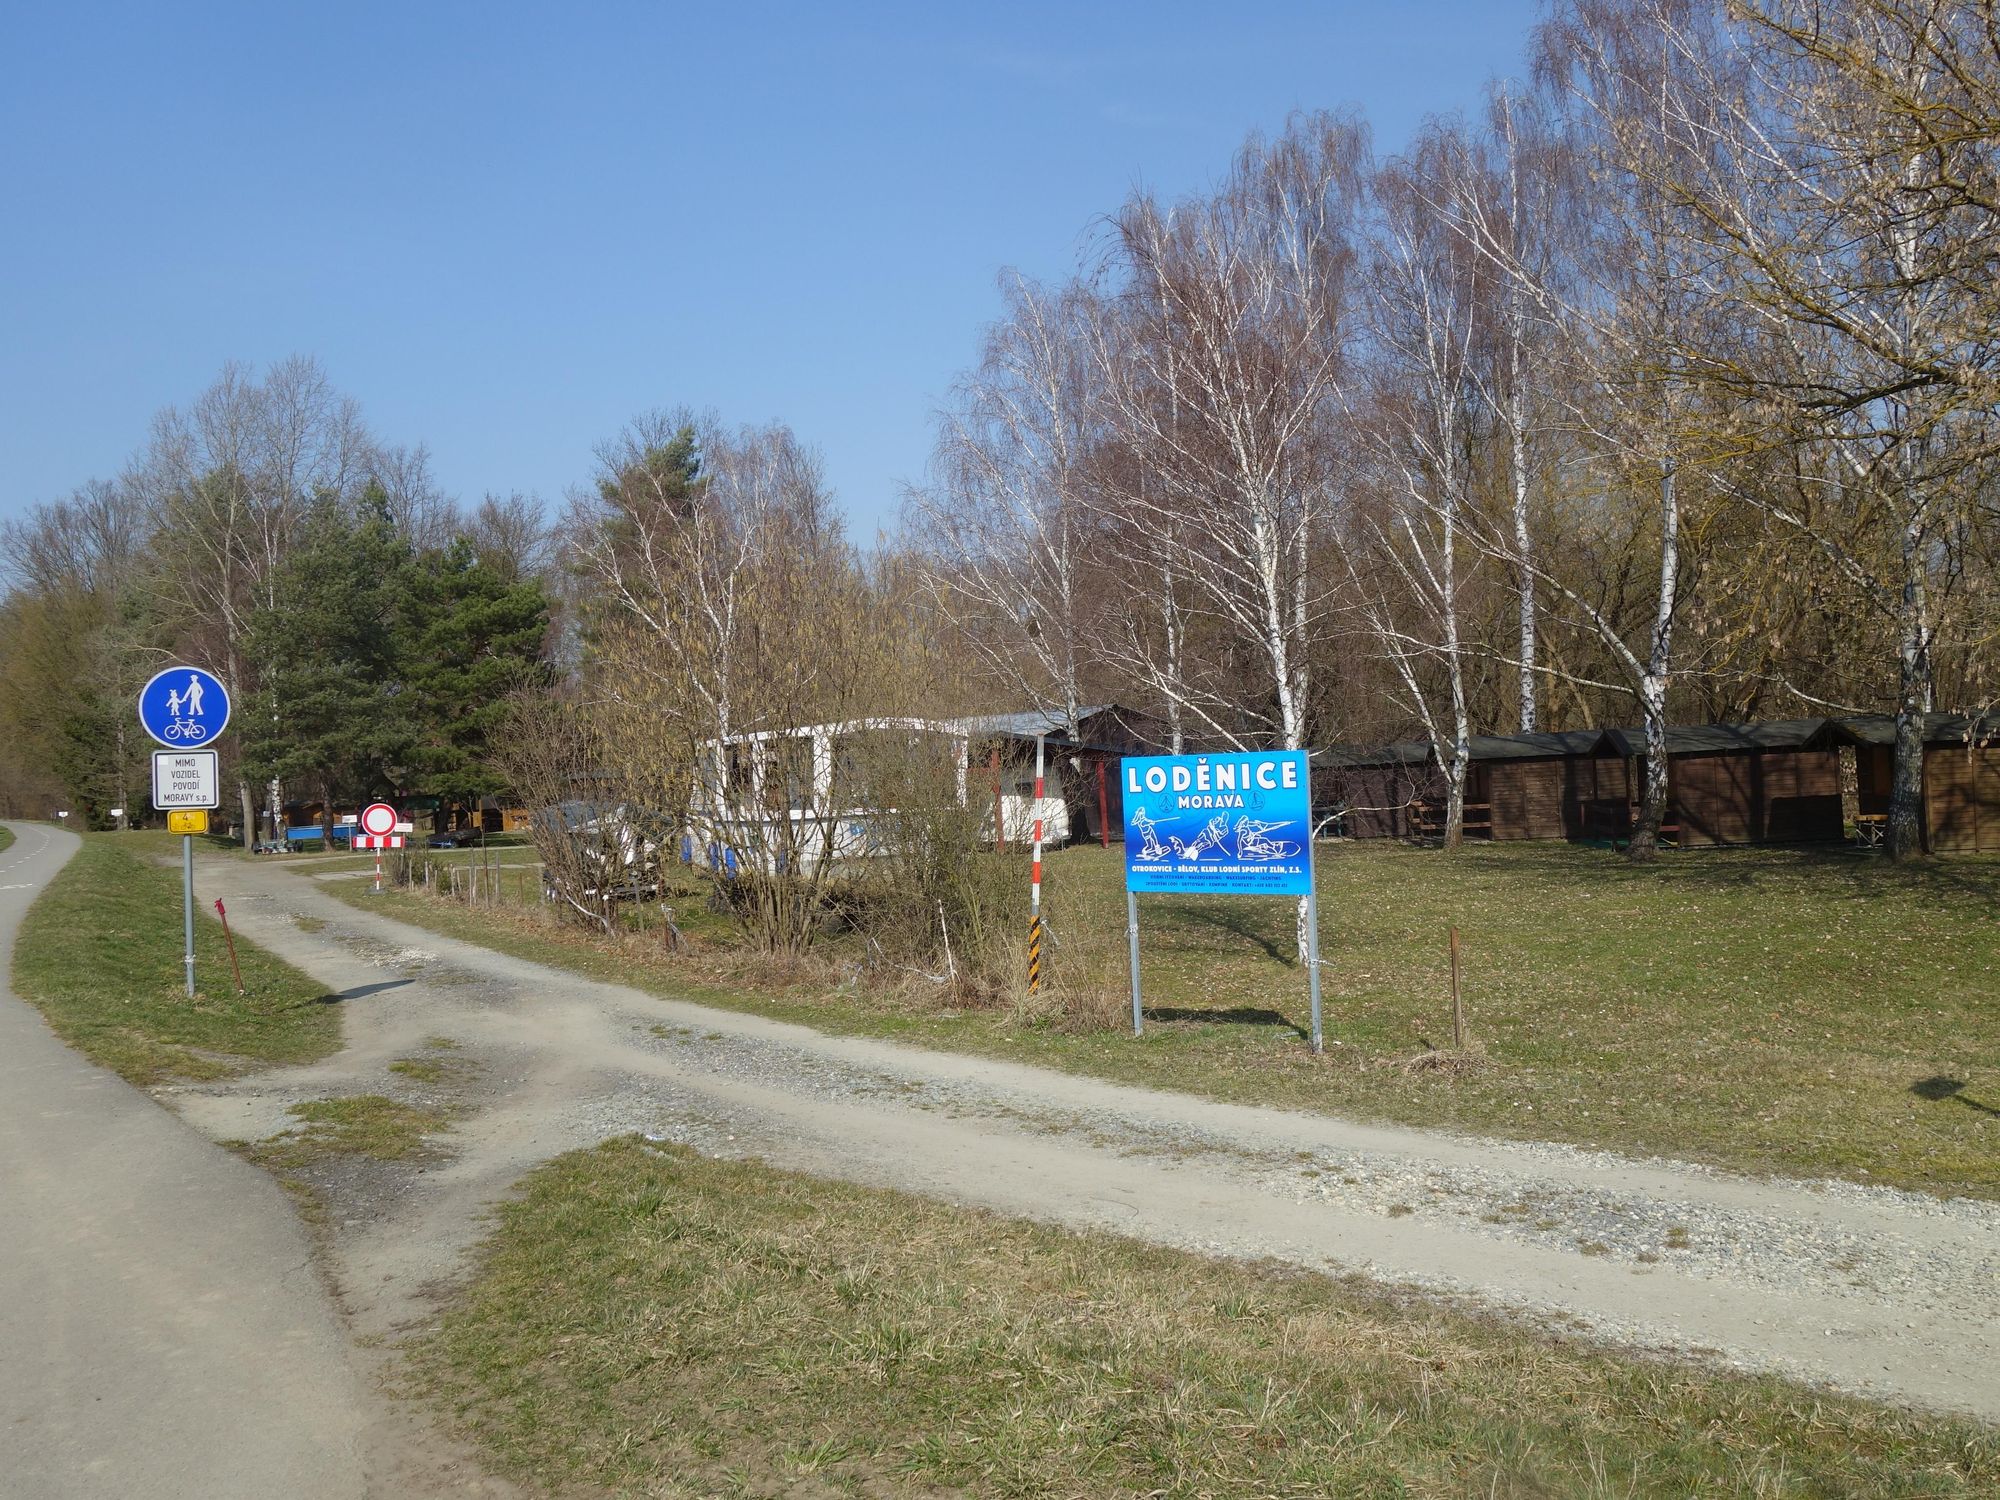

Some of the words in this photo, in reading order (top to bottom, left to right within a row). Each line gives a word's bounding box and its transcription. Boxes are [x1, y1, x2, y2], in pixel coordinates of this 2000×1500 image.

[175, 758, 196, 767] MIMO
[171, 770, 200, 779] VOZIDEL
[1128, 757, 1297, 793] LODĚNICE
[173, 780, 200, 790] POVODÍ
[164, 793, 194, 802] MORAVY
[196, 794, 209, 803] s.p.
[1178, 794, 1245, 809] MORAVA
